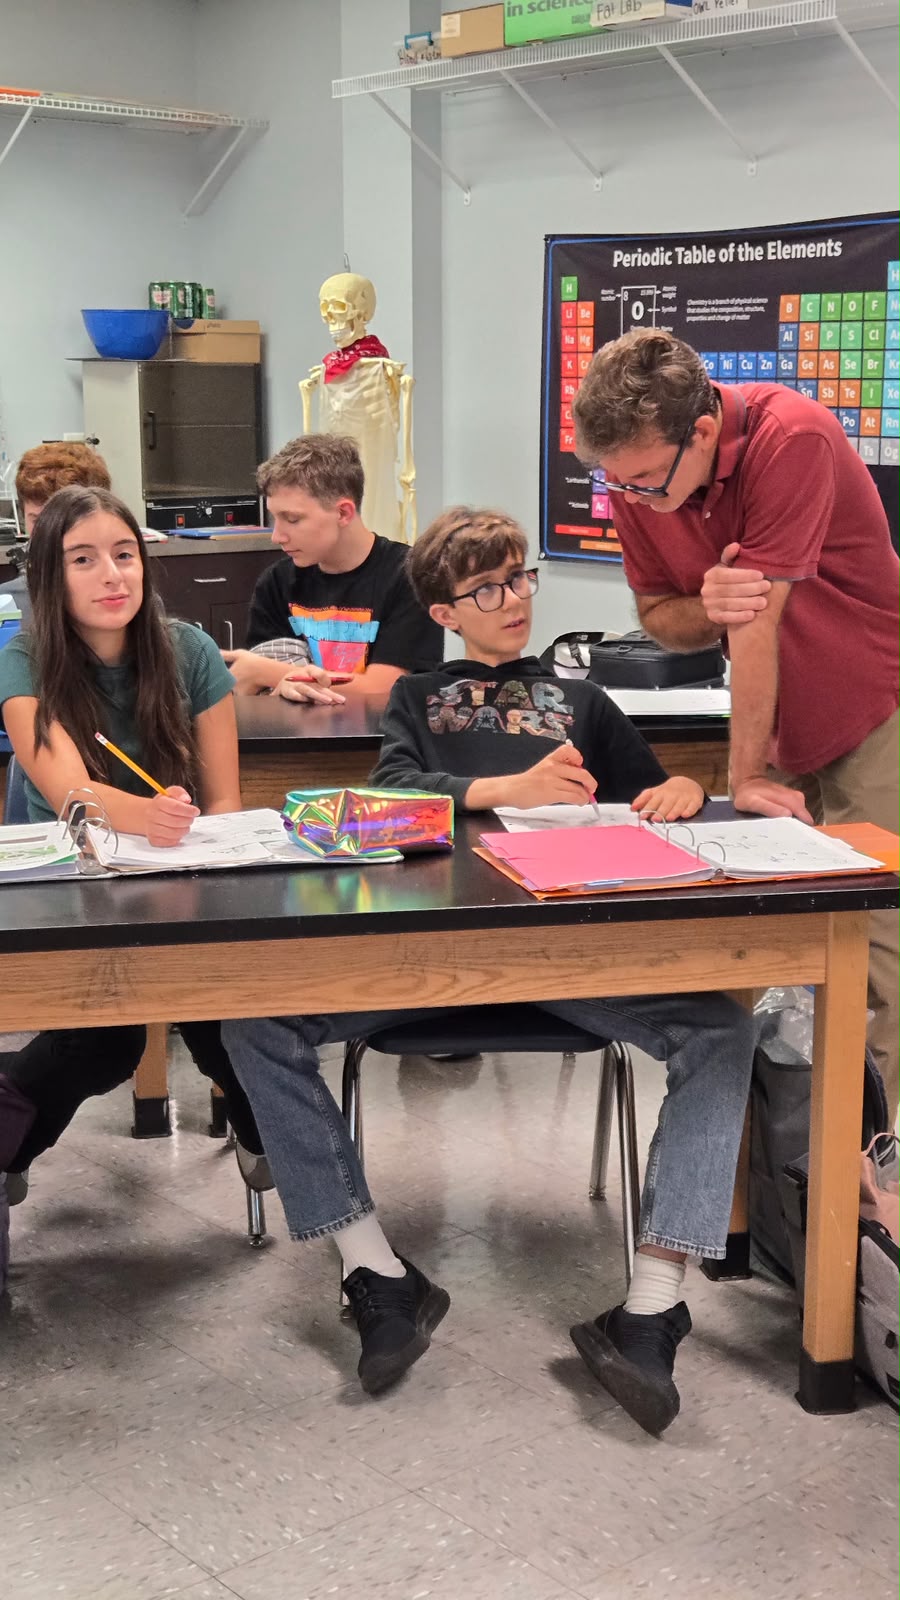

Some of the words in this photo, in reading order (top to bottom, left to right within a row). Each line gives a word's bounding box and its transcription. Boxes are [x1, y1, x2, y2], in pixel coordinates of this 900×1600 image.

[506, 1, 523, 17] in
[613, 246, 673, 268] Periodic
[674, 244, 716, 265] Table
[719, 242, 735, 263] of
[737, 241, 764, 262] the
[767, 238, 843, 260] Elements
[566, 283, 573, 293] H
[623, 290, 629, 301] 8
[631, 301, 644, 320] O
[786, 302, 793, 313] B
[806, 302, 813, 313] C
[827, 301, 835, 313] N
[848, 300, 857, 312] O
[871, 300, 878, 311] F
[566, 308, 573, 319] Li
[580, 308, 591, 319] Be
[783, 330, 793, 342] Al
[804, 329, 814, 342] Si
[826, 330, 833, 342] P
[848, 330, 855, 341] S
[869, 328, 879, 341] Cl
[566, 360, 573, 369] K
[703, 359, 715, 370] Co
[723, 359, 733, 370] Ni
[741, 359, 753, 370] Cu
[760, 359, 773, 370] Zn
[780, 359, 793, 370] Ga
[801, 359, 814, 370] Ge
[823, 359, 835, 370] As
[844, 359, 857, 370] Se
[867, 359, 879, 370] Br
[822, 387, 834, 399] Sb
[844, 387, 856, 399] Te
[887, 388, 899, 399] Xe
[842, 416, 855, 427] Po
[864, 416, 876, 428] At
[886, 417, 899, 428] Rn
[564, 435, 573, 445] Fr
[426, 679, 574, 714] STAR
[426, 705, 575, 742] WARS
